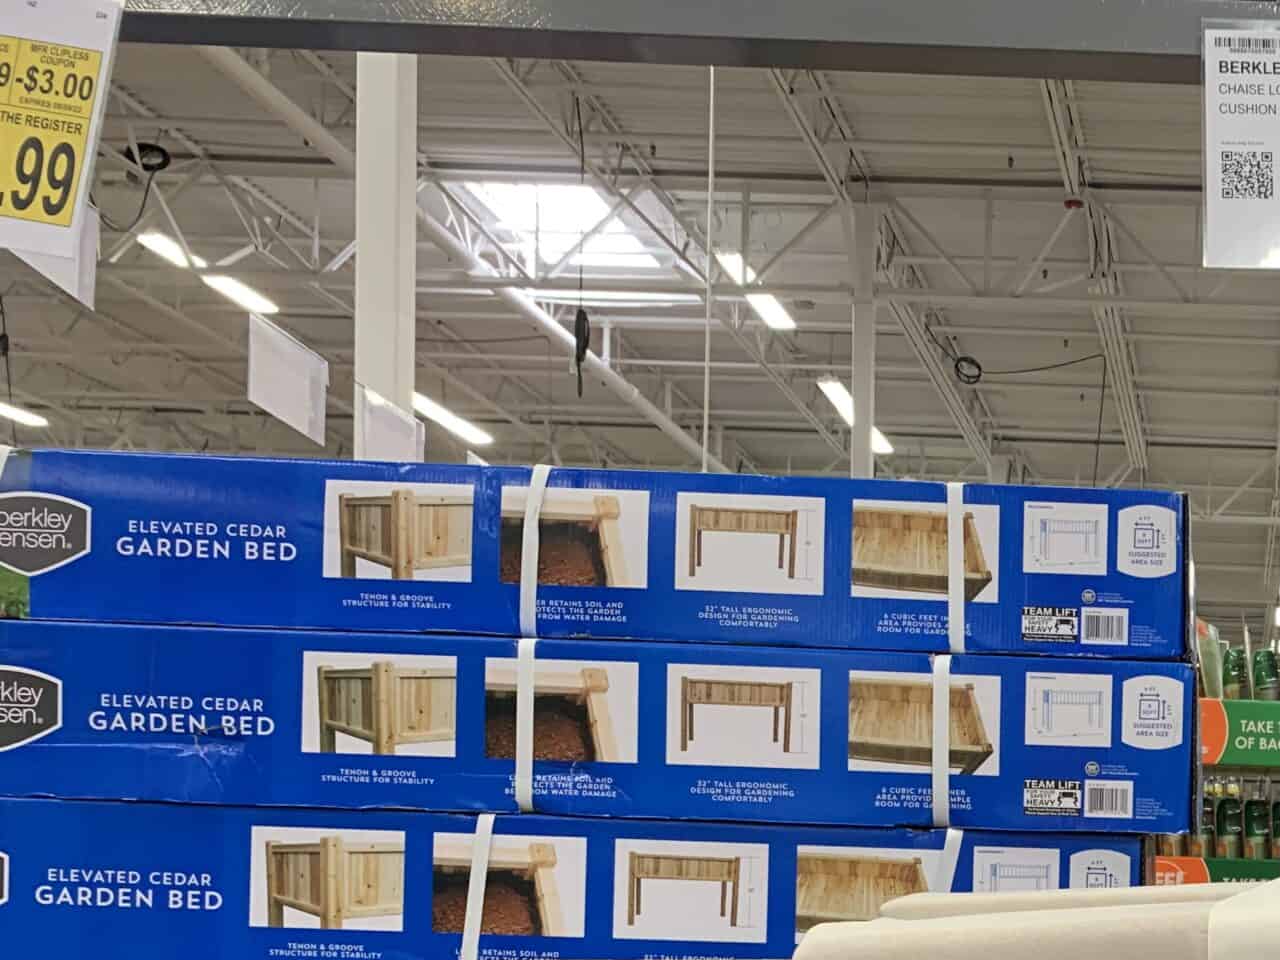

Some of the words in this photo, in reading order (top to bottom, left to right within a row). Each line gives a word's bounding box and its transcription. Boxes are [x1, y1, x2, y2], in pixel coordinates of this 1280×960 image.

[16, 65, 93, 101] -$3.00
[1219, 83, 1265, 96] CHAISE
[1219, 102, 1277, 116] CUSHION
[1, 111, 21, 125] THE
[25, 113, 82, 135] REGISTER
[128, 520, 218, 536] ELEVATED
[226, 524, 286, 539] CEDAR
[116, 537, 229, 559] GARDEN
[245, 542, 297, 561] BED
[1024, 606, 1053, 616] TEAM
[1056, 607, 1078, 617] LIFT
[101, 694, 192, 710] ELEVATED
[202, 697, 263, 712] CEDAR
[88, 711, 207, 734] GARDEN
[222, 715, 275, 736] BED
[1240, 720, 1274, 733] TAKE
[1235, 736, 1255, 750] OF
[1024, 779, 1055, 789] TEAM
[1058, 780, 1080, 790] LIFT
[47, 868, 140, 884] ELEVATED
[150, 871, 212, 886] CEDAR
[35, 885, 153, 908] GARDEN
[168, 890, 223, 911] BED
